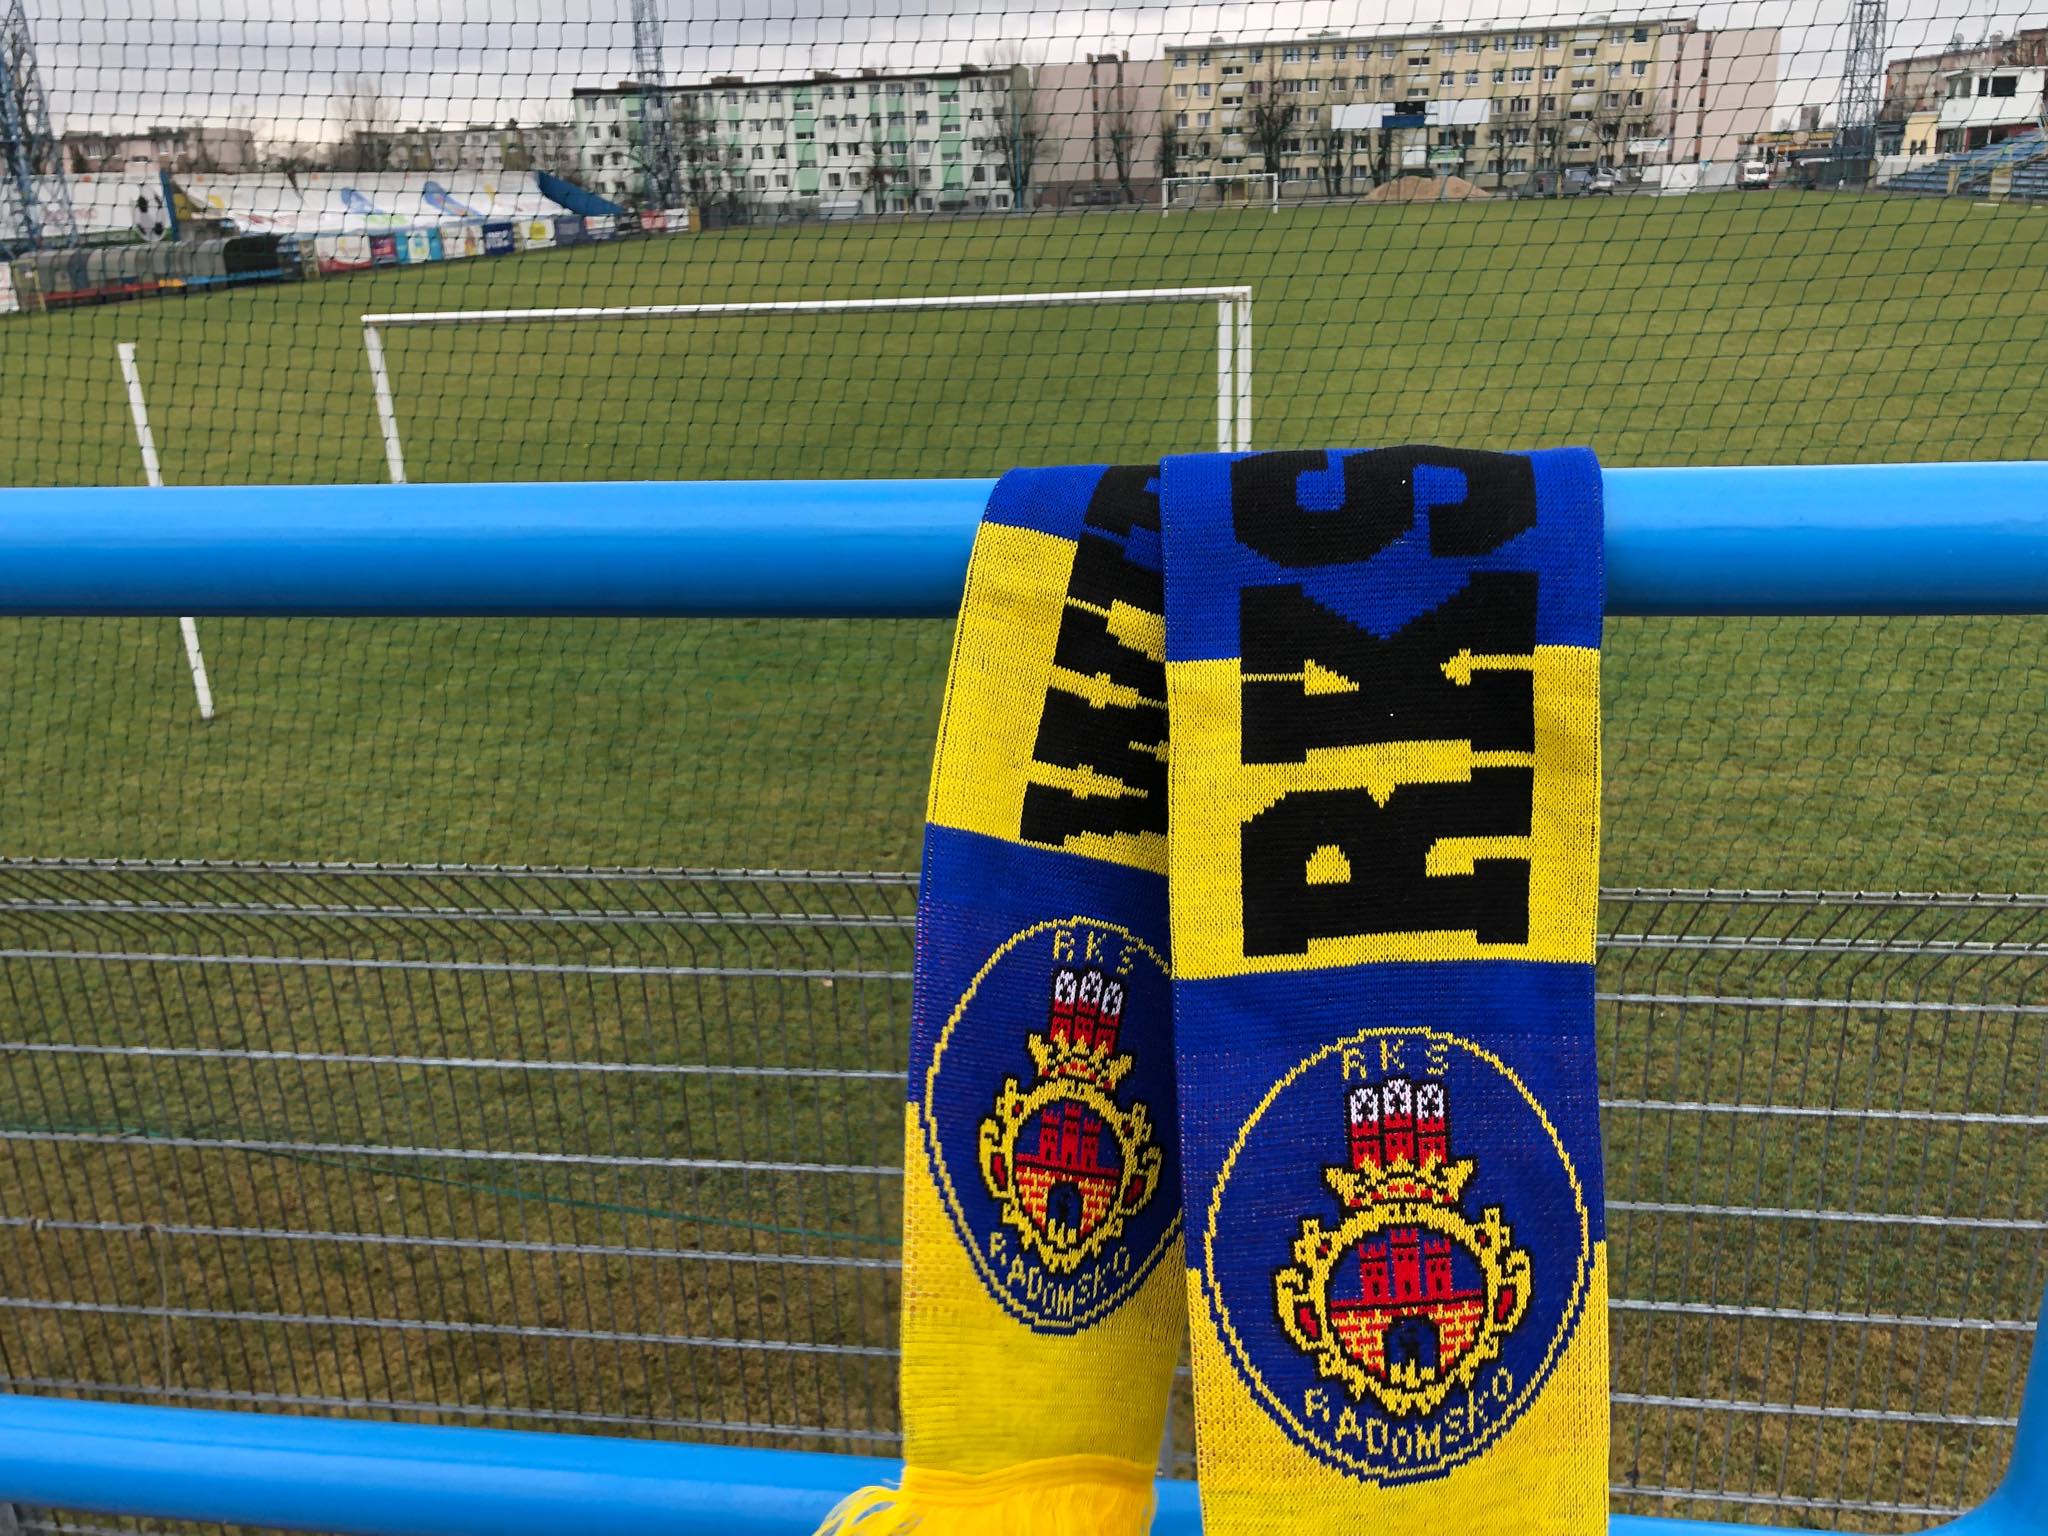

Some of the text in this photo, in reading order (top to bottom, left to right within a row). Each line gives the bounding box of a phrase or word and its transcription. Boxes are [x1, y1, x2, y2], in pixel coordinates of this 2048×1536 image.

[1231, 445, 1539, 958] RKS
[1051, 928, 1138, 975] RKS
[1341, 1038, 1450, 1080] RKS
[988, 1230, 1130, 1316] RADOMSKO
[1304, 1367, 1514, 1465] RADOMSKO
